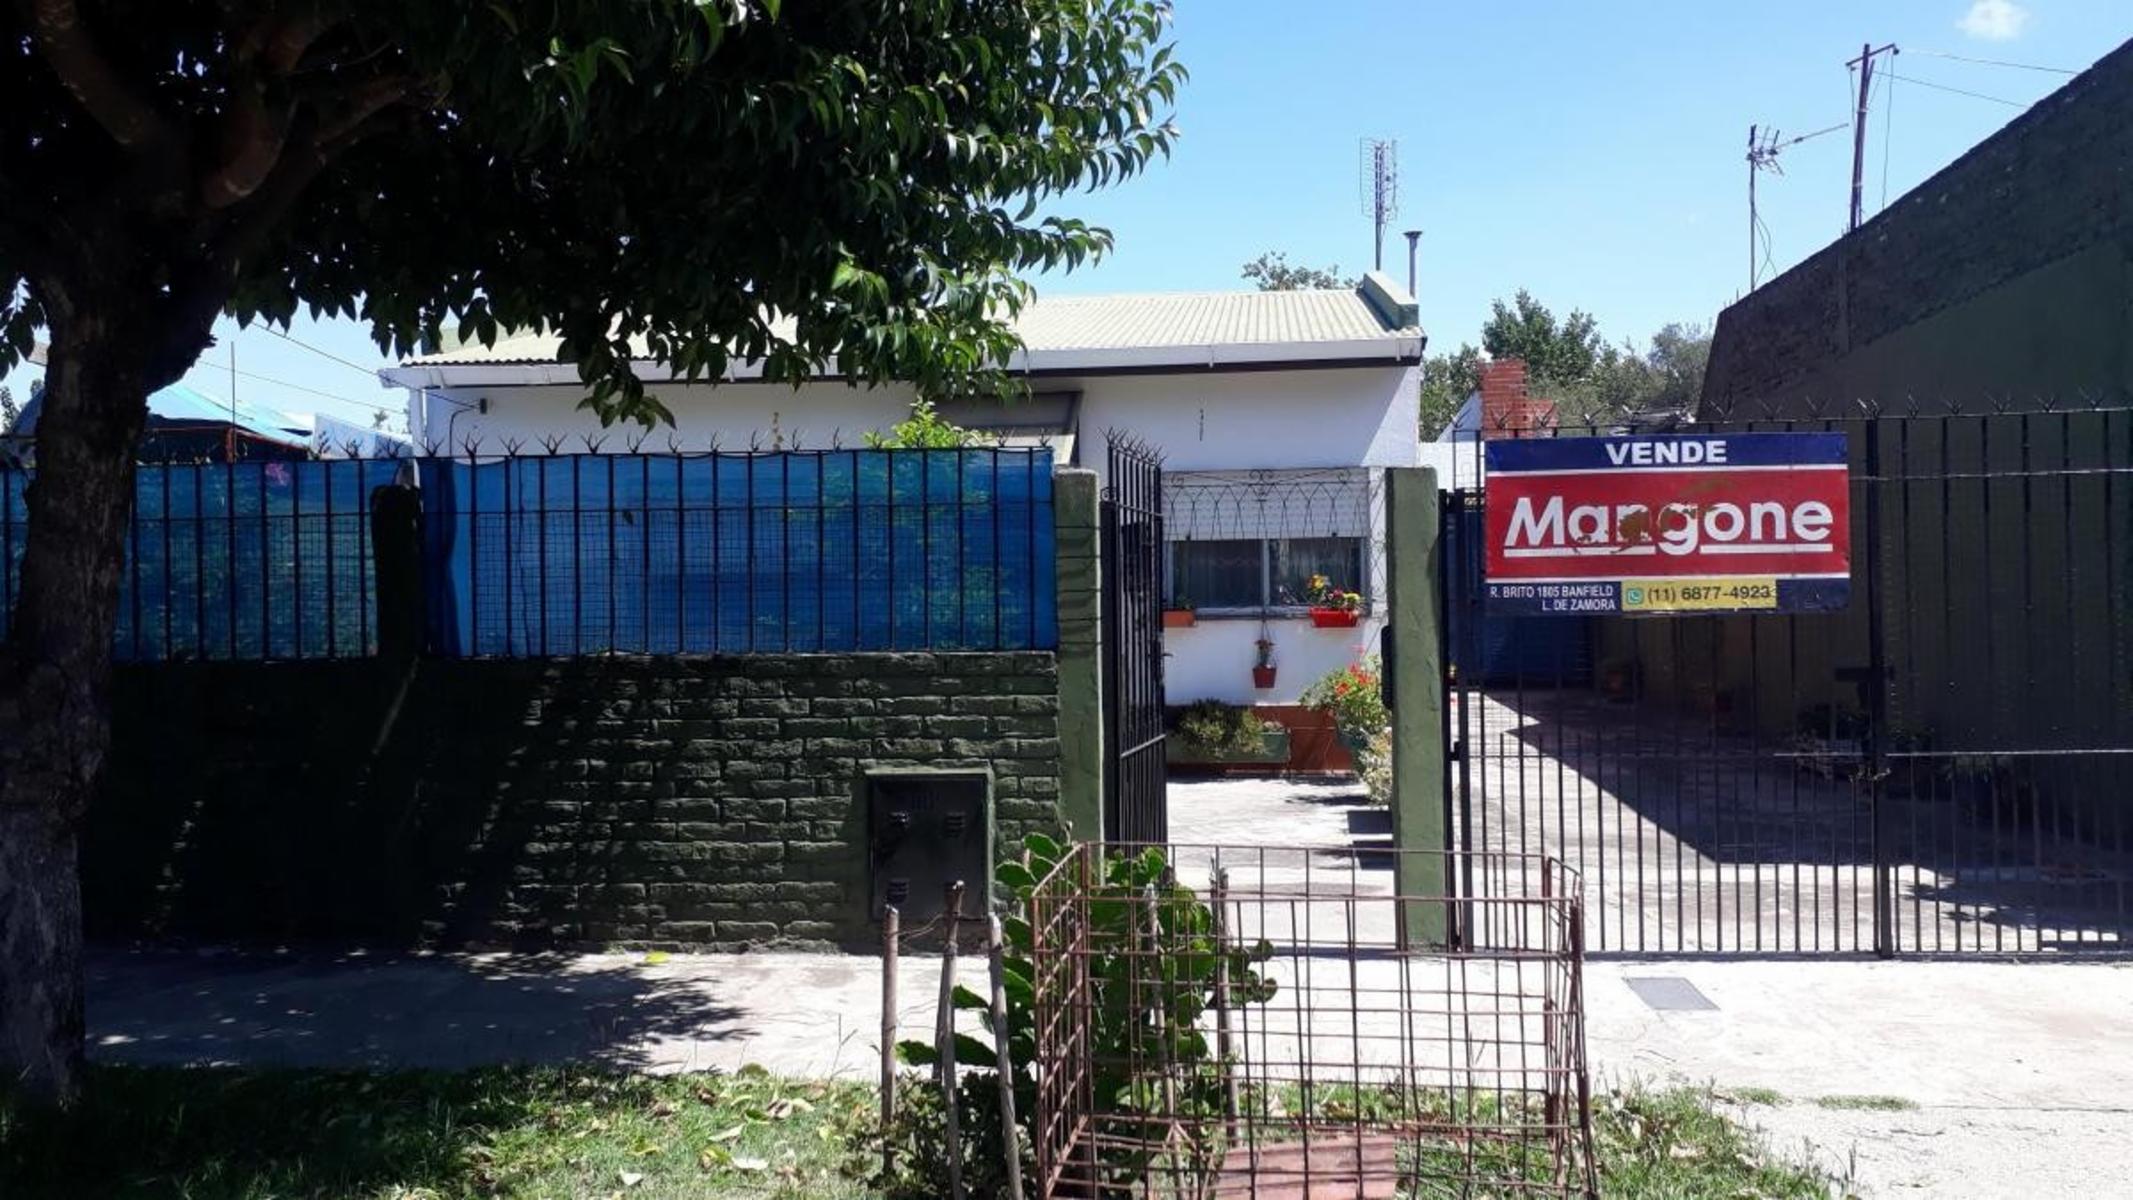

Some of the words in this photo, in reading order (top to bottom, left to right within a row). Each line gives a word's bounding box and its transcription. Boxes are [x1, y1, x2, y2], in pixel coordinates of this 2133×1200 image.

[1605, 439, 1728, 466] VENDE
[1503, 495, 1835, 556] Mangone
[1490, 586, 1501, 598] R.
[1503, 586, 1535, 598] BRITO
[1561, 585, 1613, 598] BANFIELD
[1647, 587, 1677, 604] (11)
[1681, 585, 1771, 601] 6877-4923
[1553, 599, 1569, 611] DE
[1570, 598, 1616, 611] ZAMORA
